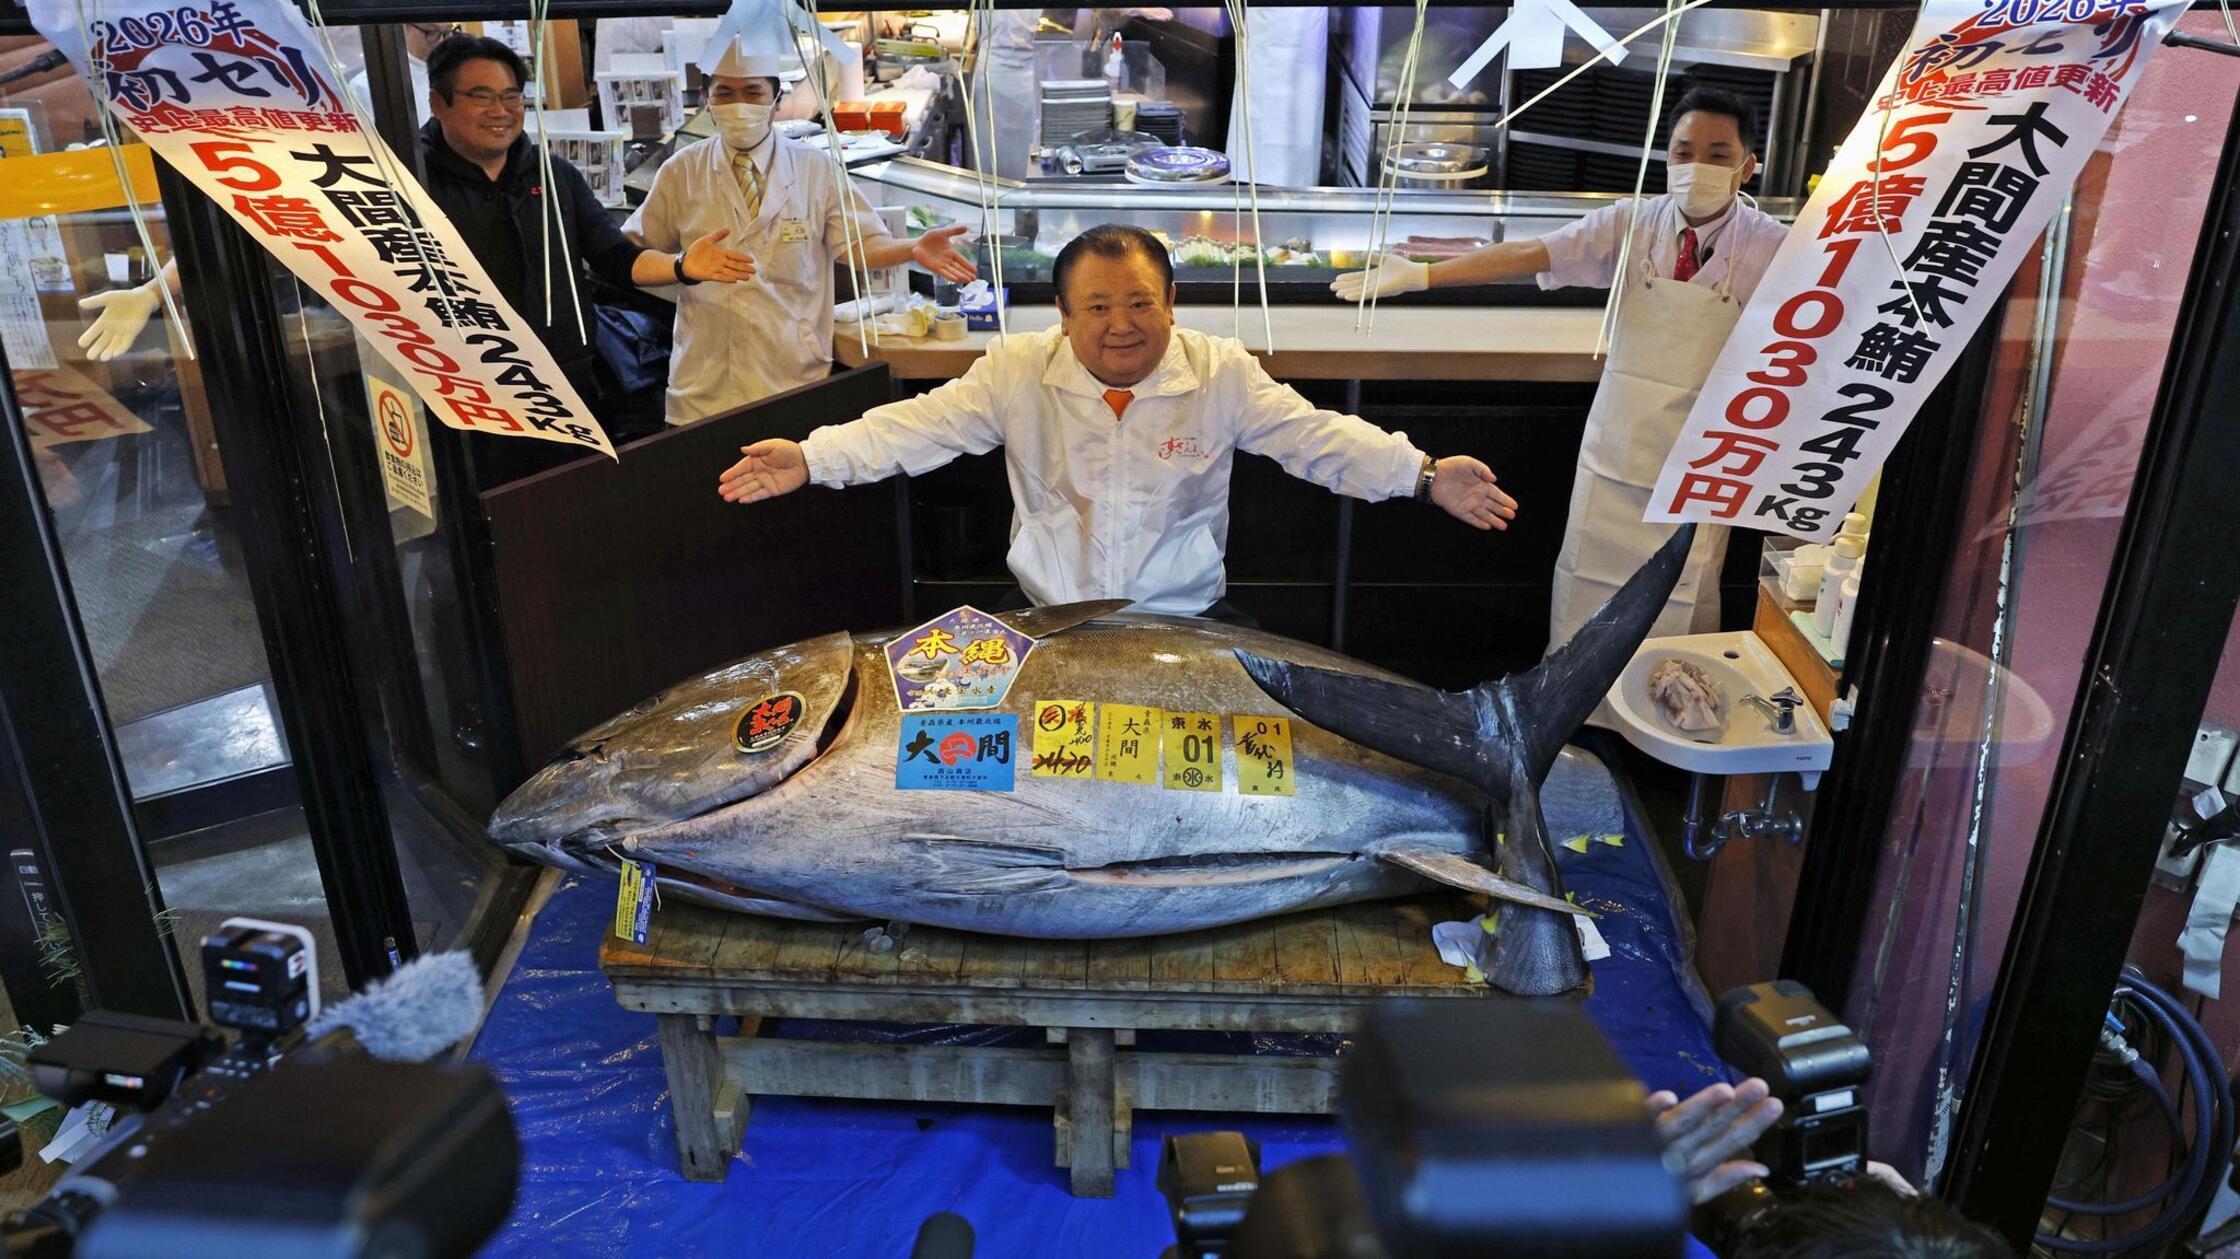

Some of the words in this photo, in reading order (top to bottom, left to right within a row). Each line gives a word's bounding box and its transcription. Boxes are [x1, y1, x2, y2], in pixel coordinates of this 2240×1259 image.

[91, 1, 254, 51] 2026年
[86, 47, 321, 112] 初セリ
[1872, 64, 2121, 115] 史上最高値更新
[126, 106, 360, 134] 史上最高値更新
[189, 142, 525, 432] 5億1030万円
[1667, 112, 1953, 519] 5億1030万円
[1120, 717, 1142, 759] 大間
[1171, 716, 1212, 731] 東水
[1257, 722, 1281, 735] 01
[1183, 734, 1214, 764] 01
